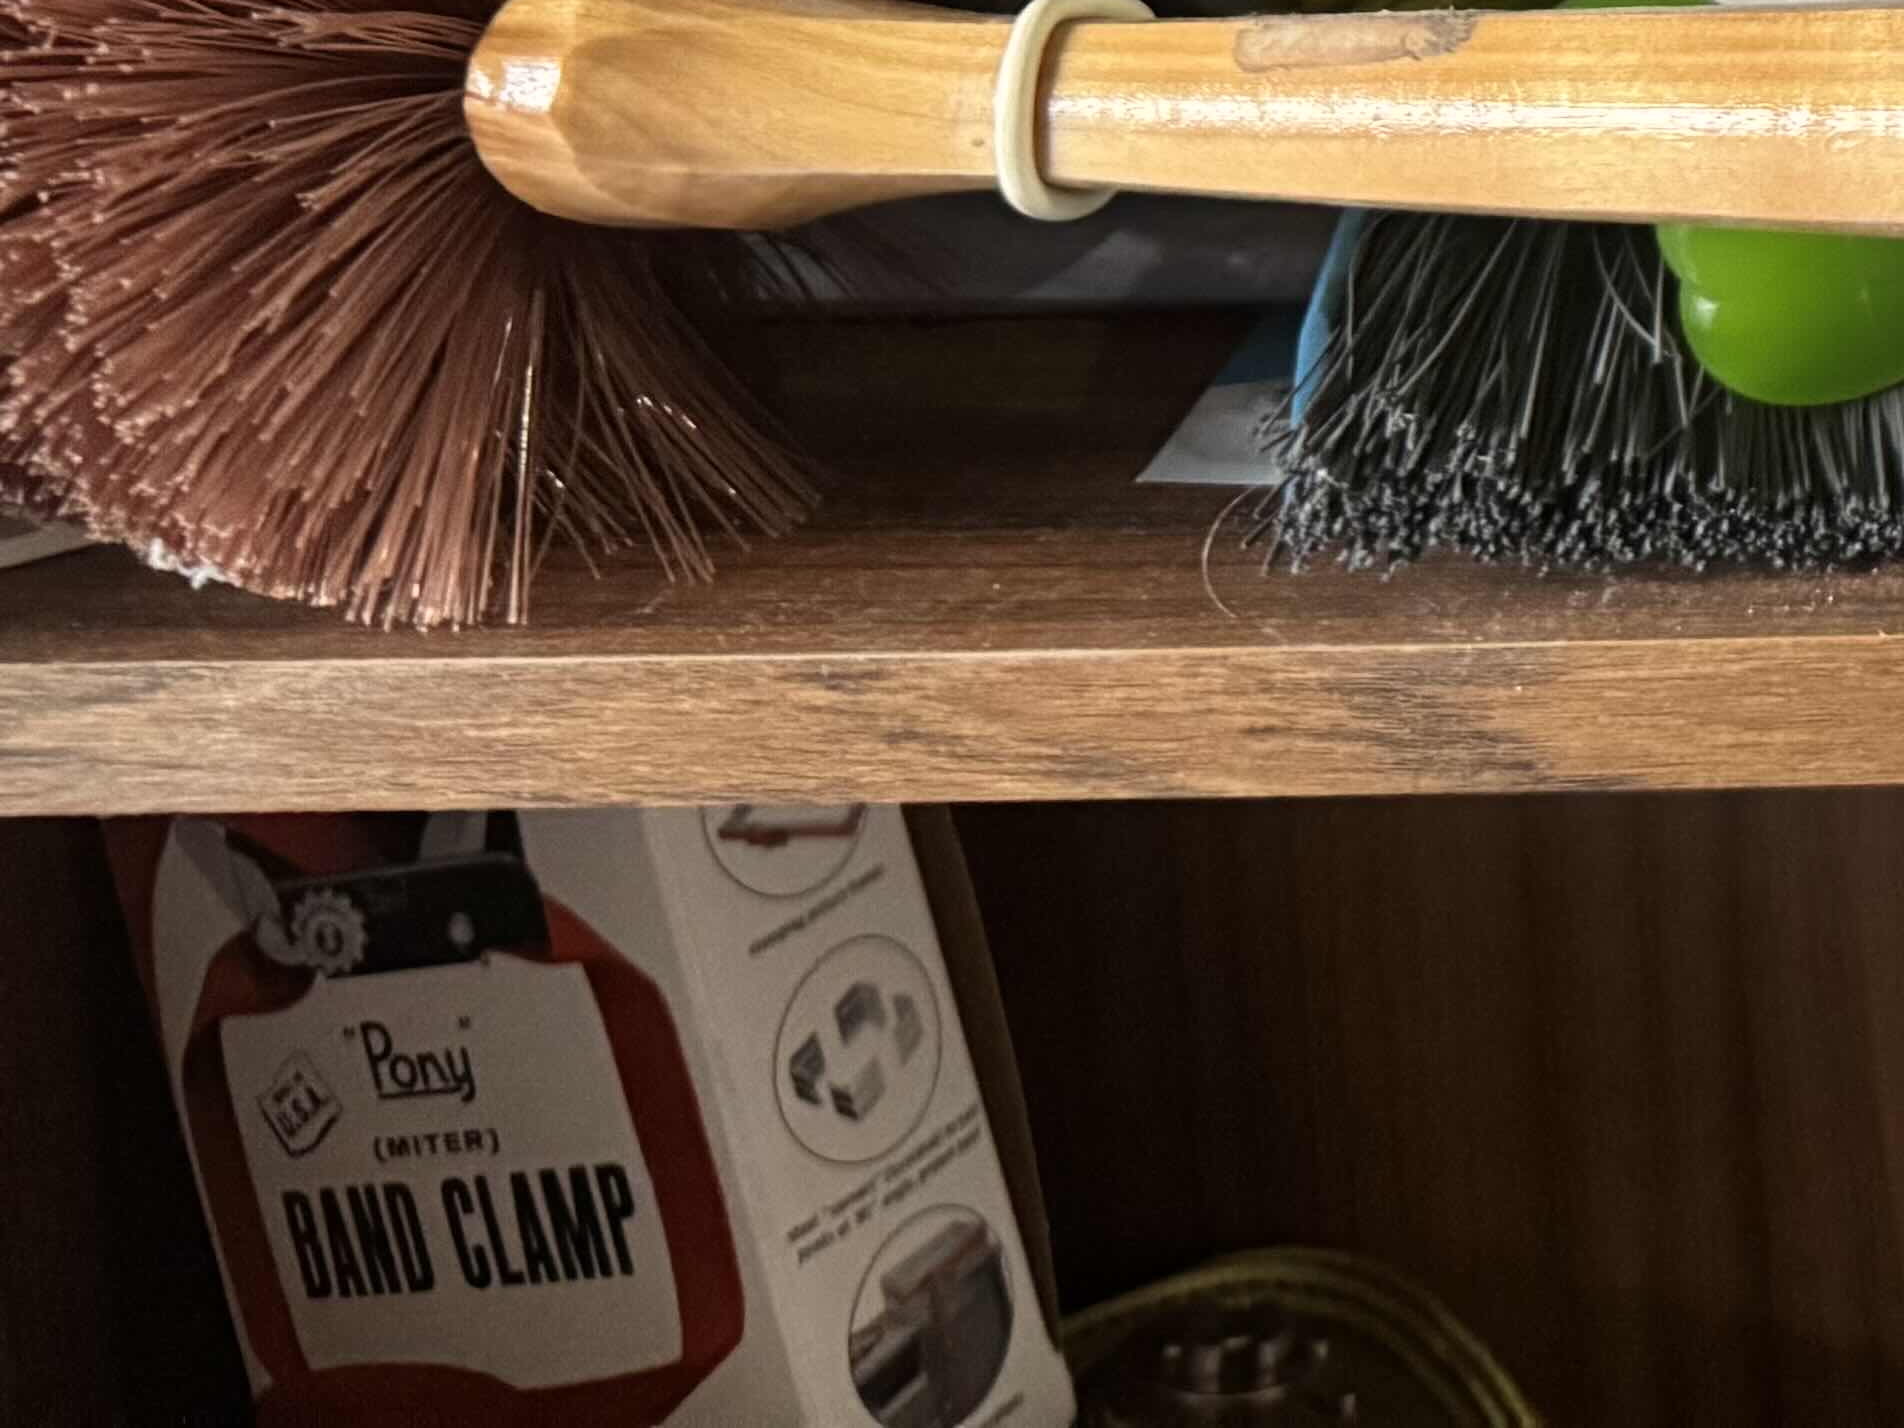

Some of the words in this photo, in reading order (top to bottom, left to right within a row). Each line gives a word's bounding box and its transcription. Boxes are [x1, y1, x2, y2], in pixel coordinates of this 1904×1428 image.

[374, 1128, 500, 1163] (MITER)
[284, 1182, 434, 1299] BAND
[442, 1164, 634, 1290] CLAMP
